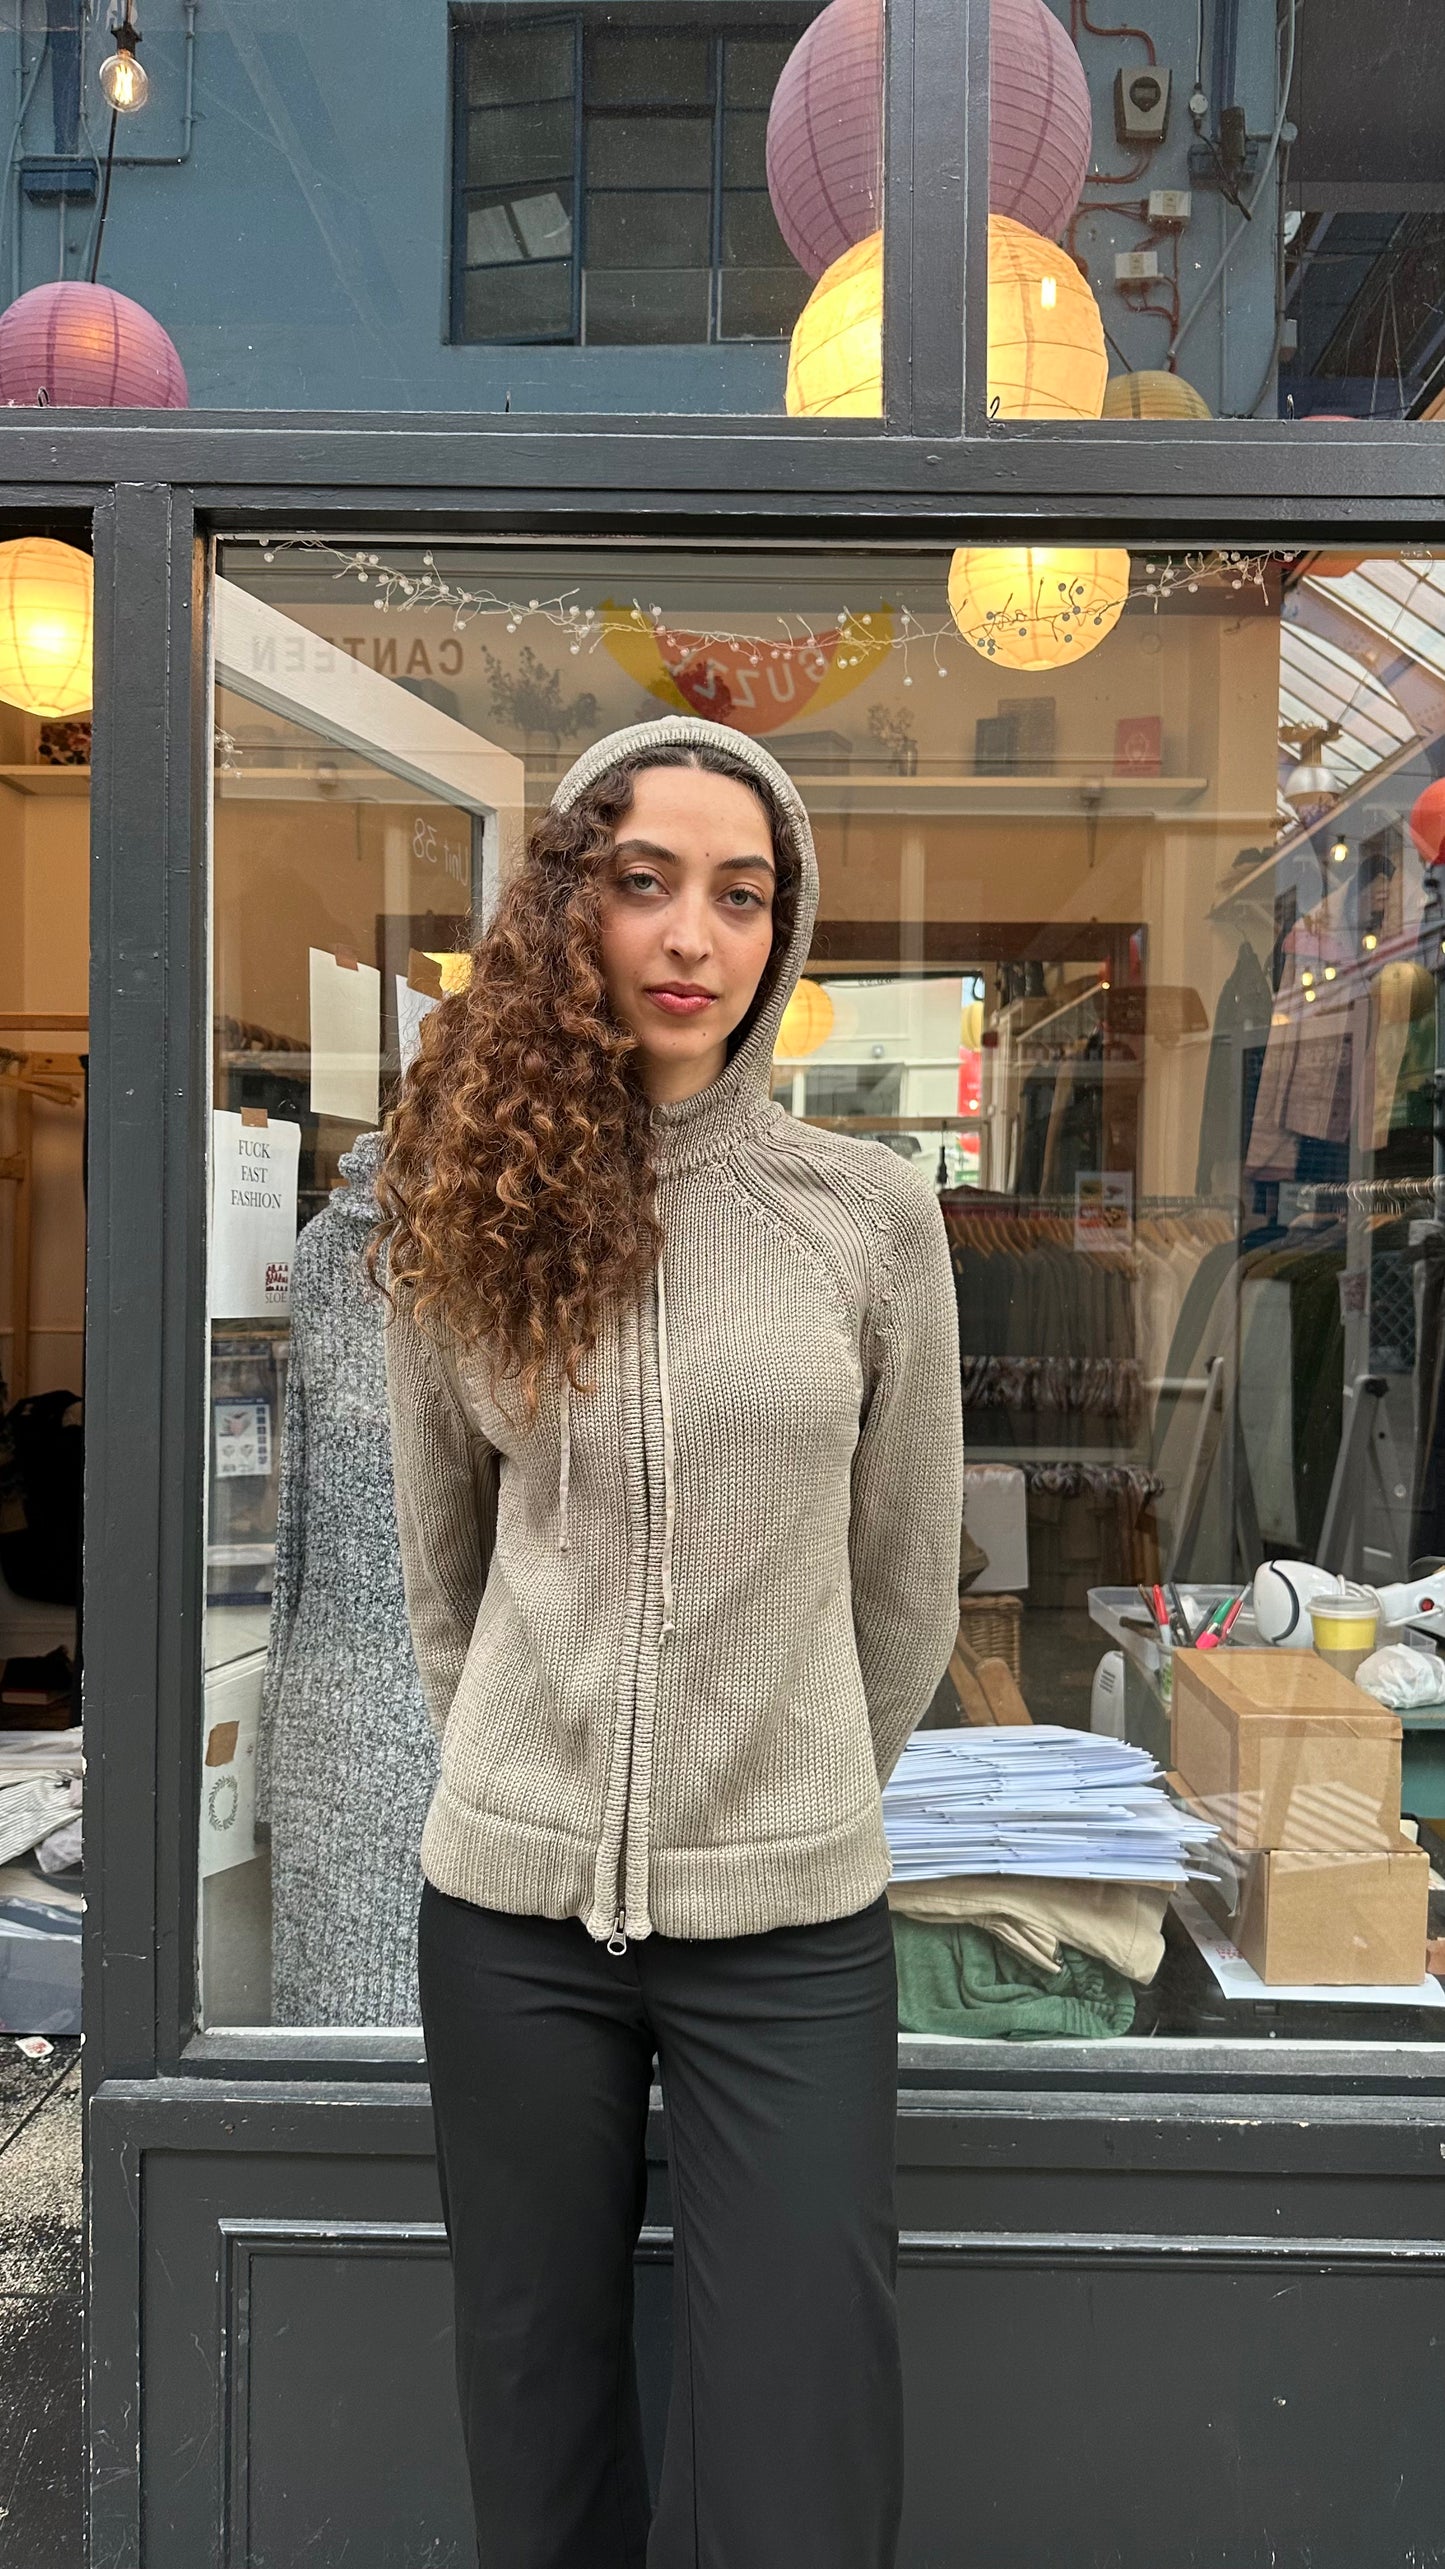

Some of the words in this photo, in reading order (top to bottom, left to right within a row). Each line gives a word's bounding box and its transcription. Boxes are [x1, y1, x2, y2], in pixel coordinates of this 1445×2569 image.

[239, 1139, 271, 1159] FUCK
[241, 1165, 268, 1183] FAST
[231, 1189, 282, 1208] FASHION
[265, 1292, 287, 1304] SLOE
